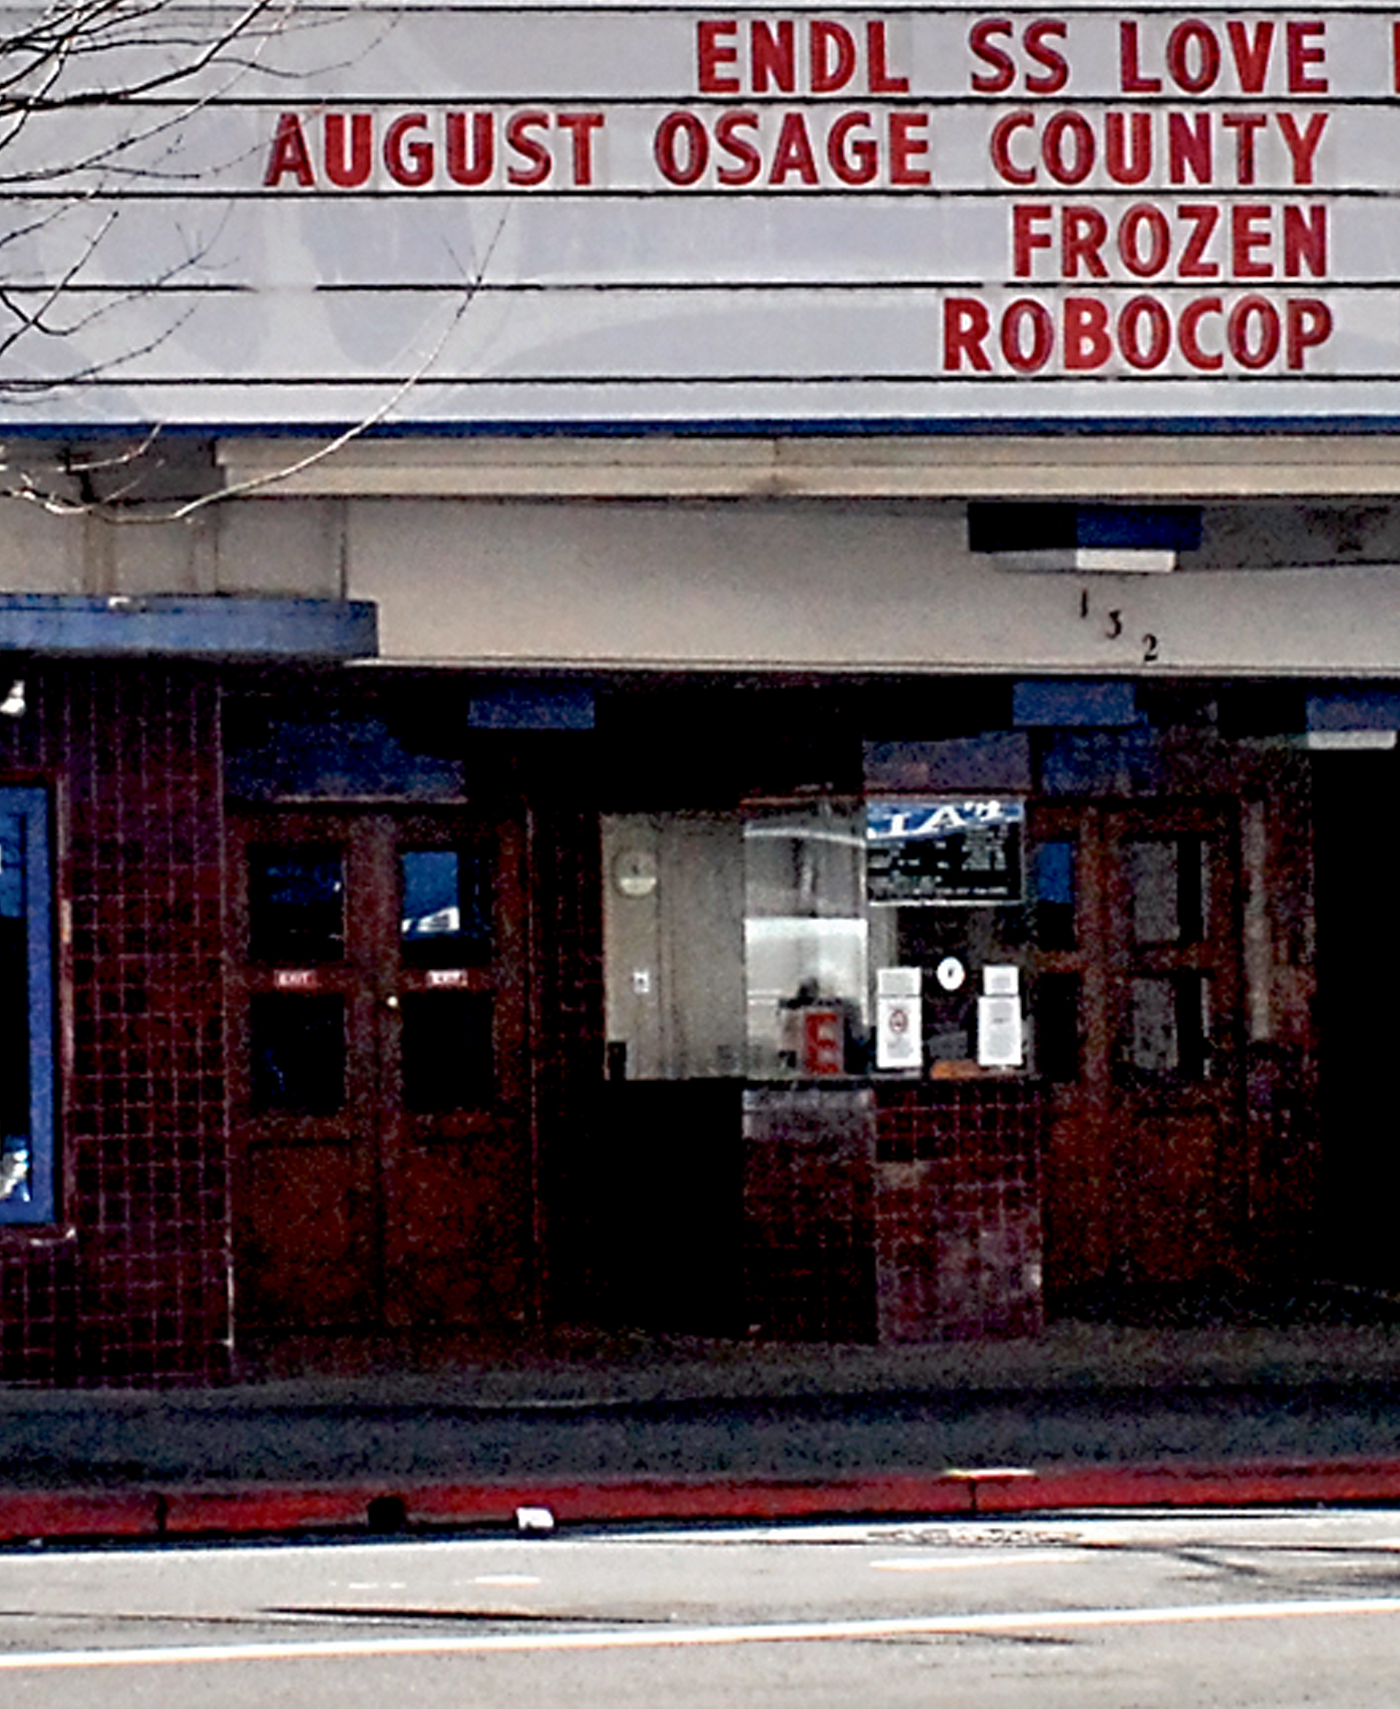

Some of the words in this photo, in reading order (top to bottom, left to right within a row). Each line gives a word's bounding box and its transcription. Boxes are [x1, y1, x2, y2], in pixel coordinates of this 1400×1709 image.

[697, 19, 909, 94] ENDL
[968, 18, 1070, 94] SS
[1119, 19, 1330, 94] LOVE
[264, 111, 604, 187] AUGUST
[653, 111, 932, 186] OSAGE
[990, 111, 1331, 186] COUNTY
[1012, 204, 1329, 278] FROZEN
[942, 296, 1334, 373] ROBOCOP
